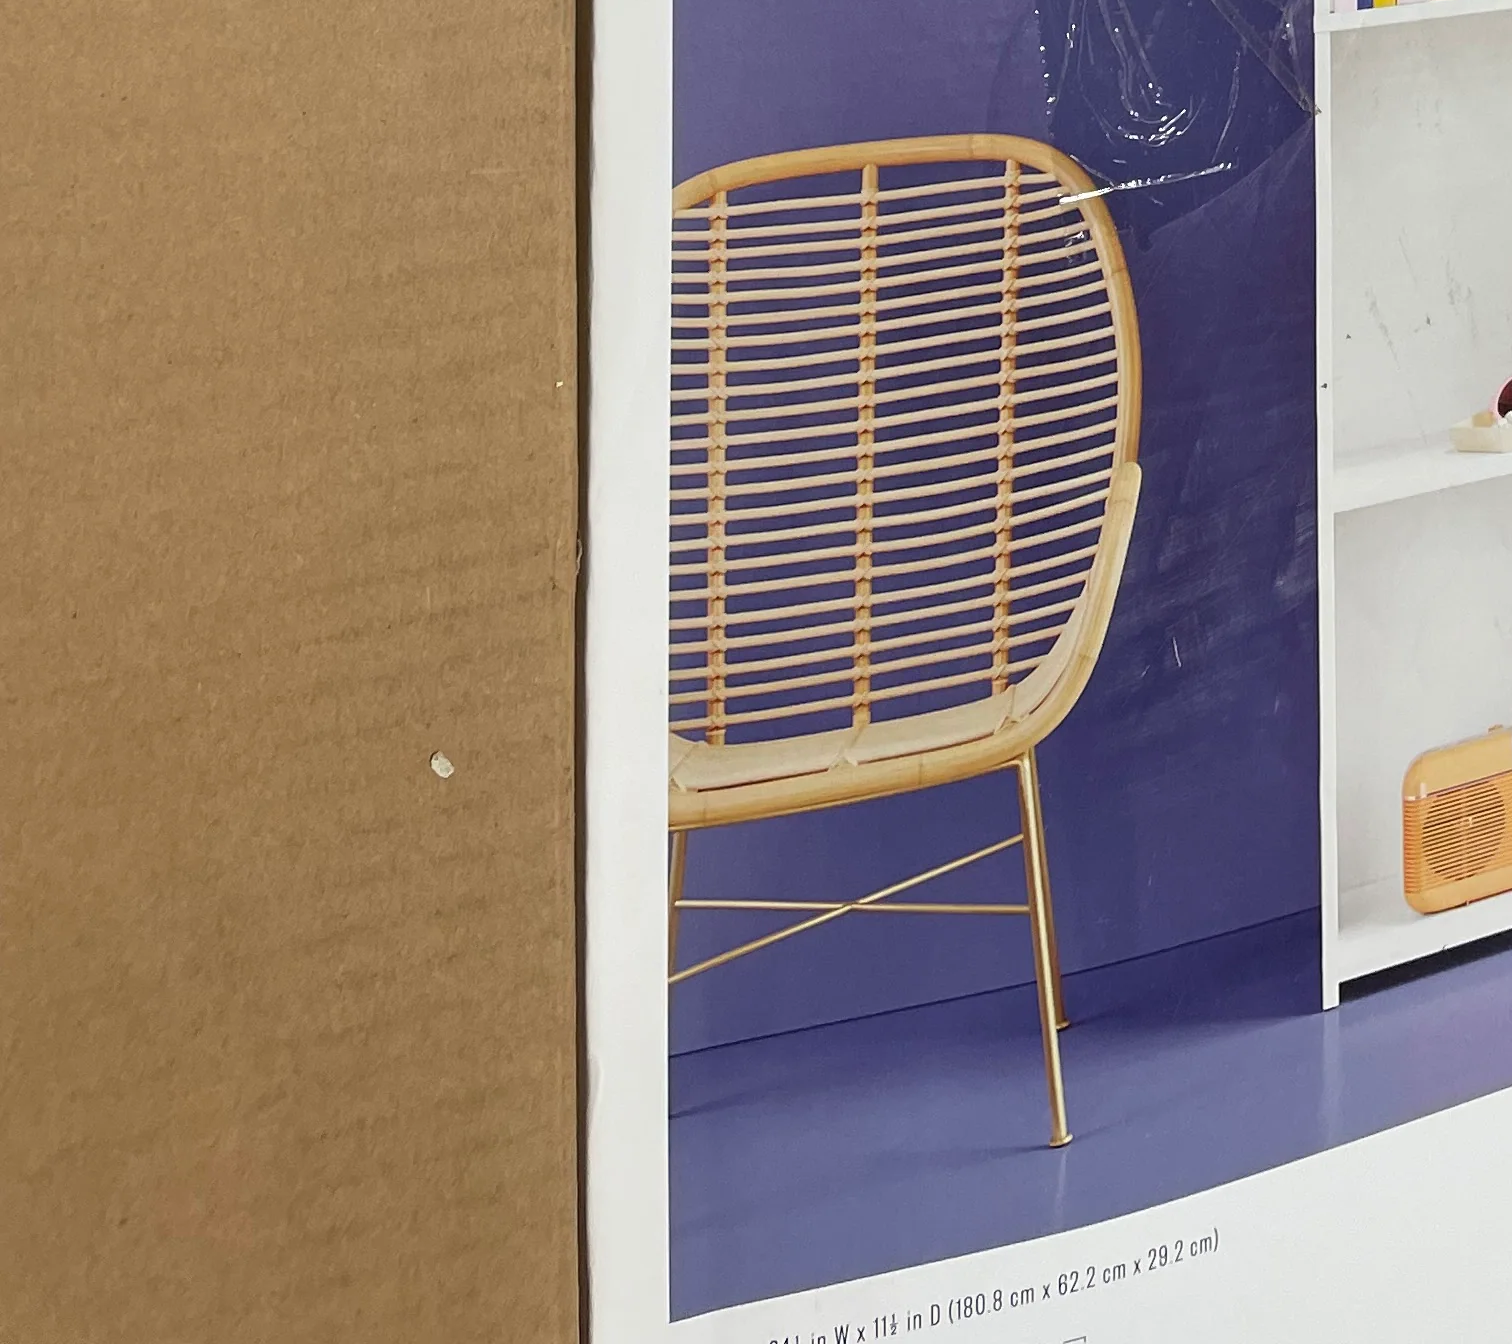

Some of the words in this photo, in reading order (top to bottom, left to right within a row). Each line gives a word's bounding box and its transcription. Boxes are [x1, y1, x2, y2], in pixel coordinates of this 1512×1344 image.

[834, 1323, 850, 1344] W
[856, 1324, 867, 1343] x
[907, 1310, 922, 1333] in
[930, 1304, 941, 1327] D
[948, 1289, 1003, 1325] (180.8
[1010, 1288, 1036, 1309] cm
[1042, 1283, 1052, 1302] x
[1057, 1267, 1097, 1297] 62.2
[1102, 1262, 1127, 1285] cm
[1133, 1258, 1142, 1276] x
[1147, 1238, 1185, 1272] 29.2
[1189, 1227, 1220, 1259] cm)
